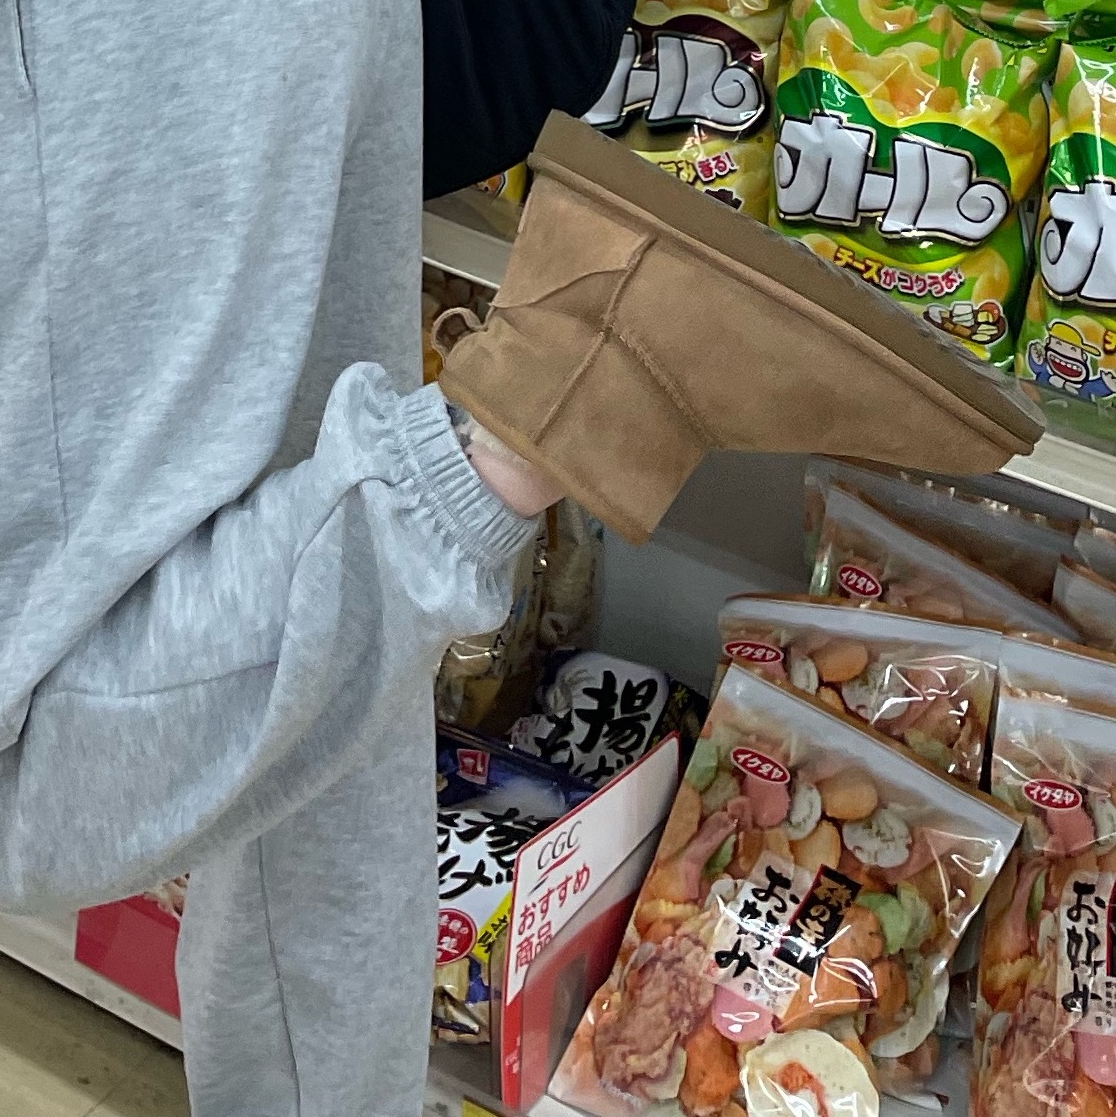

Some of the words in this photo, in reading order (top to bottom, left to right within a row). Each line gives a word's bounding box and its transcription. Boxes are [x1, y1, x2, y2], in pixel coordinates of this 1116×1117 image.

[582, 28, 766, 132] ール
[773, 112, 1011, 246] カール
[537, 820, 582, 870] CGC
[517, 863, 591, 937] おすすめ
